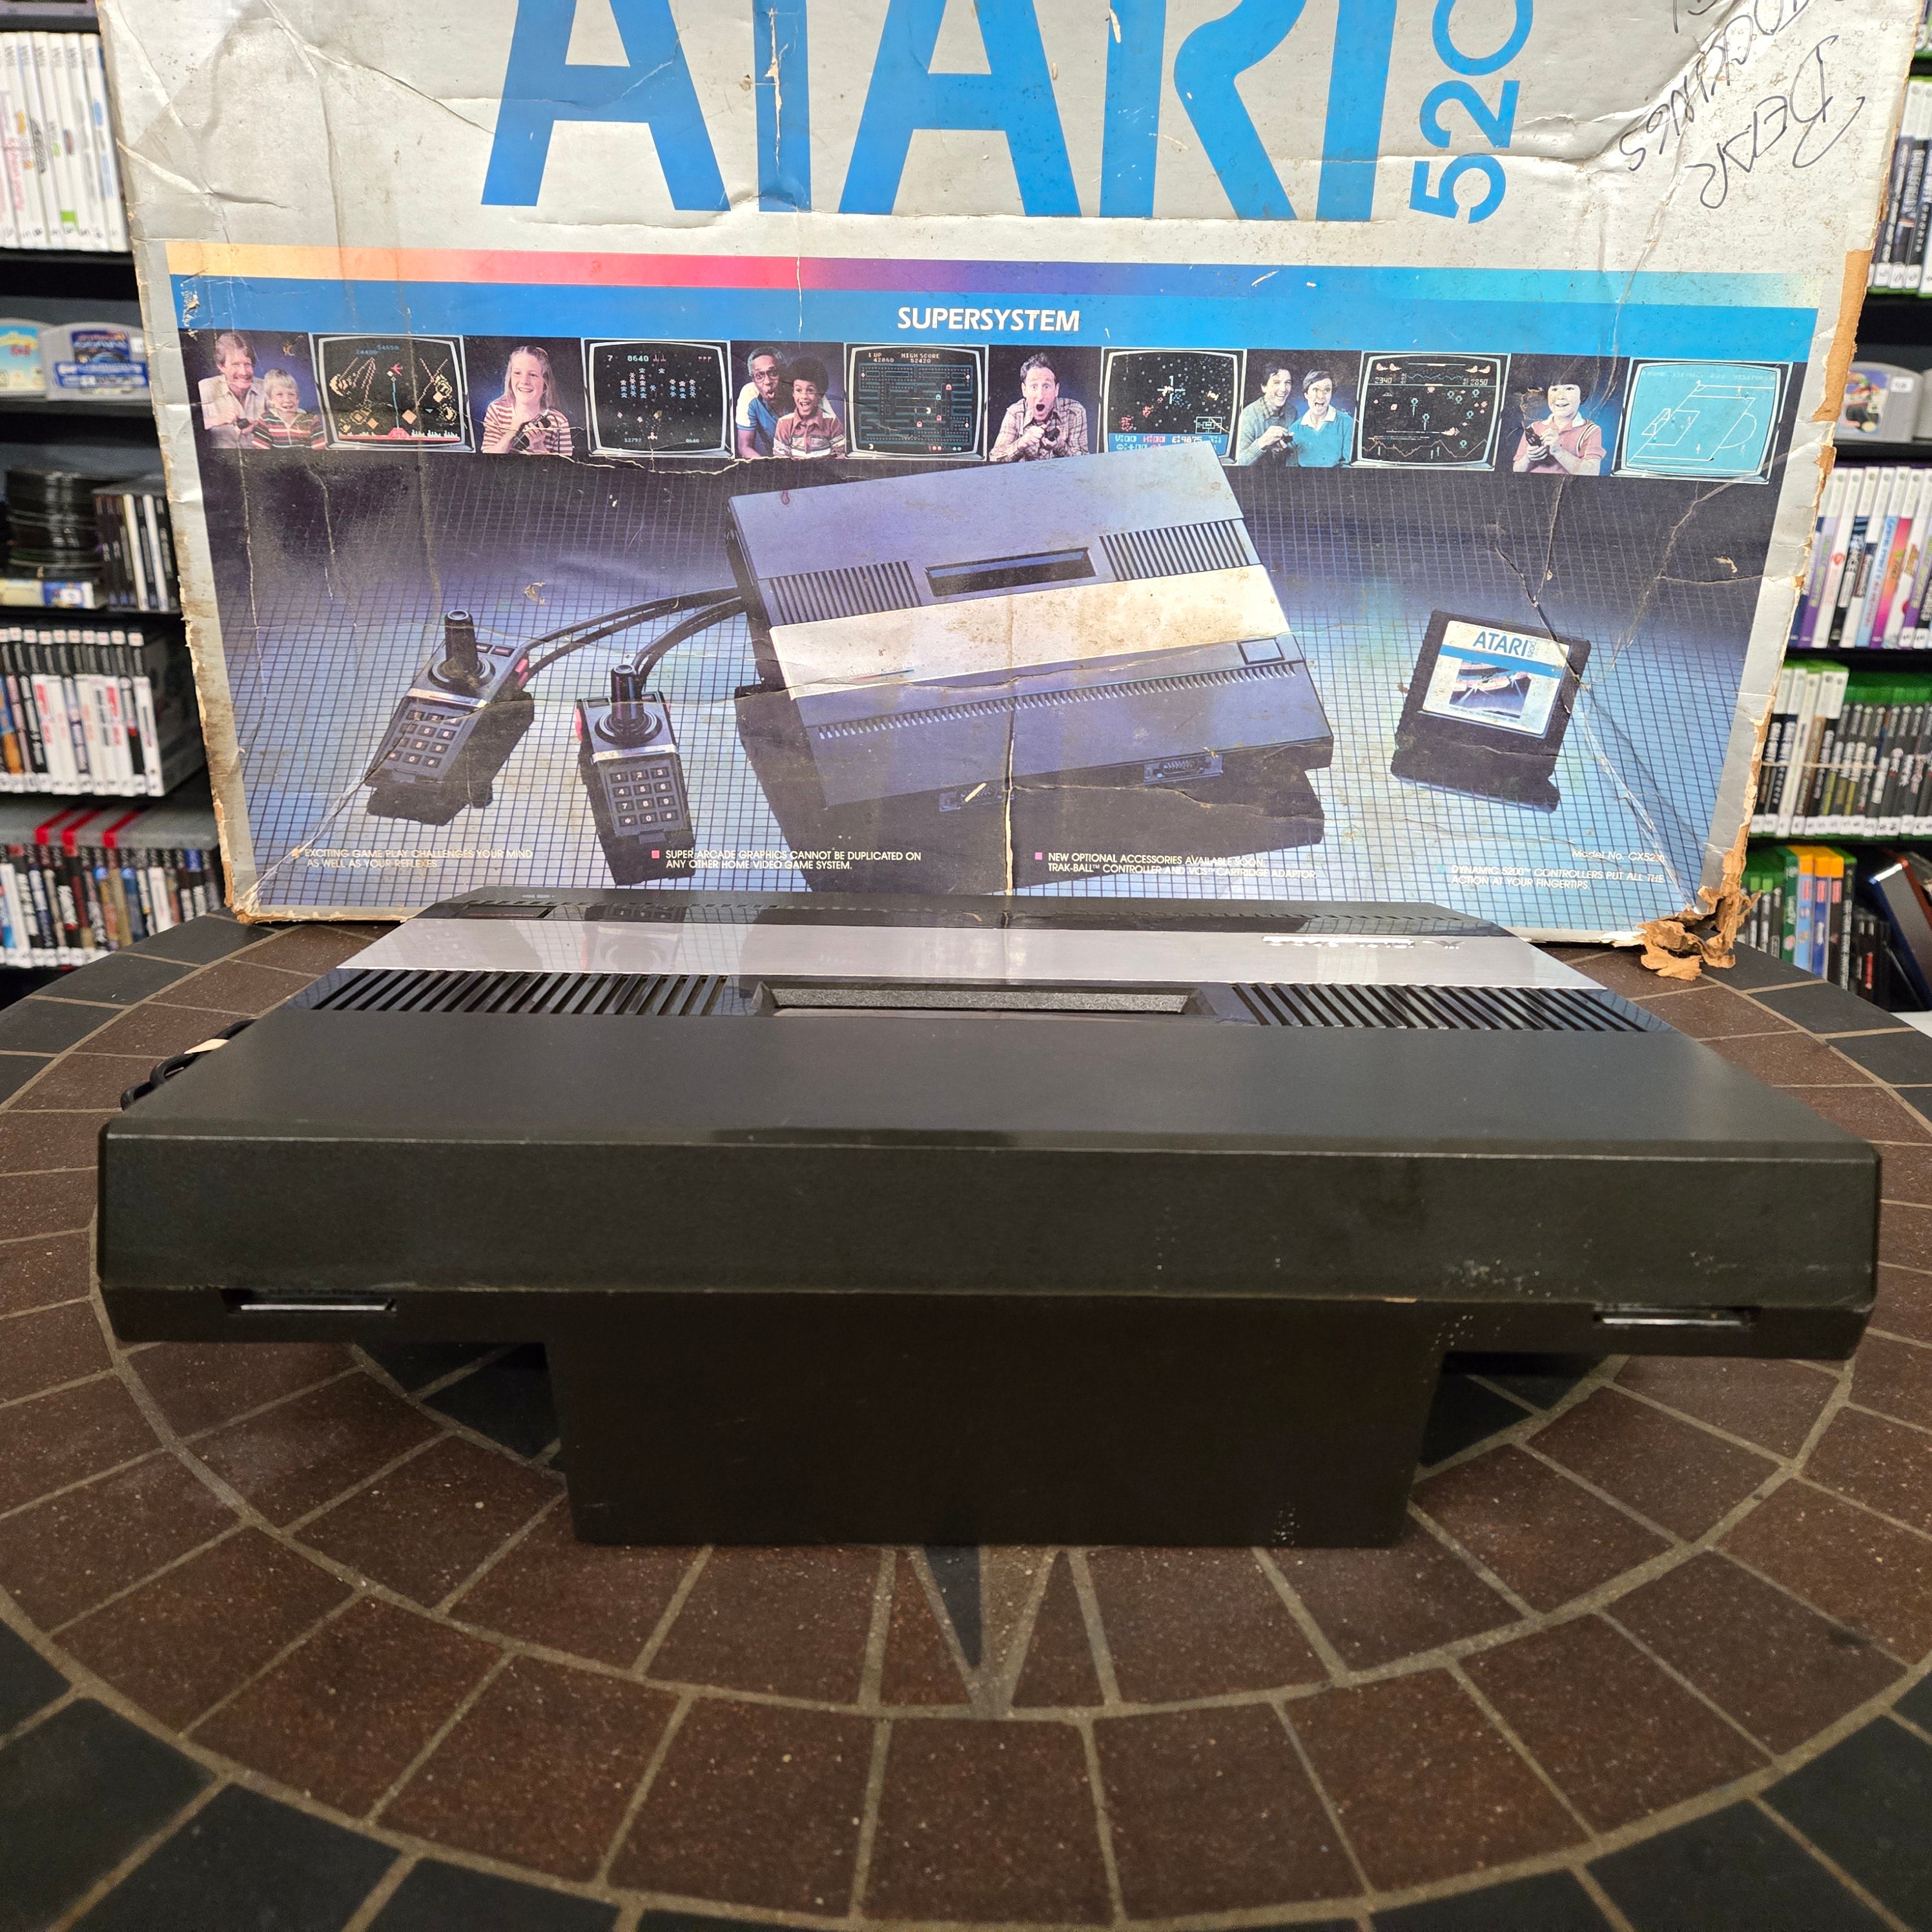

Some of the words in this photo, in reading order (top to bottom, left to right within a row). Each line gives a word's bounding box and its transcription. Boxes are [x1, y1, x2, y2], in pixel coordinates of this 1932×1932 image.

[898, 307, 1080, 332] SUPERSYSTEM
[1472, 631, 1528, 657] ATARI
[305, 848, 349, 858] EXCITING
[352, 849, 383, 858] GAME
[385, 849, 409, 858] PLAY
[411, 849, 474, 859] CHALLENGES
[477, 849, 504, 859] YOUR
[506, 849, 534, 859] MIND
[666, 850, 694, 859] SUPER
[697, 850, 736, 859] ARCADE
[738, 850, 787, 859] GRAPHICS
[790, 850, 832, 860] CANNOT
[834, 850, 845, 860] BE
[847, 851, 903, 861] DUPLICATED
[905, 852, 921, 861] ON
[1048, 852, 1069, 862] NEW
[1071, 853, 1117, 863] OPTIONAL
[1120, 854, 1182, 865] ACCESSORIES
[1185, 855, 1232, 867] AVAILABLE
[1572, 848, 1605, 859] Model
[1608, 851, 1625, 860] No.
[1628, 852, 1665, 863] CX520
[307, 859, 320, 868] AS
[323, 859, 346, 868] WELL
[348, 859, 362, 868] AS
[362, 859, 392, 868] YOUR
[666, 859, 686, 868] ANY
[688, 859, 719, 868] OTHER
[721, 859, 750, 869] HOME
[752, 860, 782, 869] VIDEO
[784, 860, 814, 870] GAME
[816, 861, 852, 870] SYSTEM.
[1102, 864, 1162, 874] CONTROLLER
[1164, 866, 1186, 875] AND
[1216, 867, 1269, 878] CARTRIDGE
[1451, 865, 1501, 875] DYNAMIC
[1534, 868, 1603, 879] CONTROLLERS
[1605, 871, 1624, 880] PUT
[1626, 872, 1644, 881] ALL
[1647, 873, 1665, 883] THE
[1451, 876, 1489, 885] ACTION
[1492, 876, 1505, 885] AT
[1506, 876, 1534, 887] YOUR
[1536, 878, 1592, 890] FINGERTIPS.
